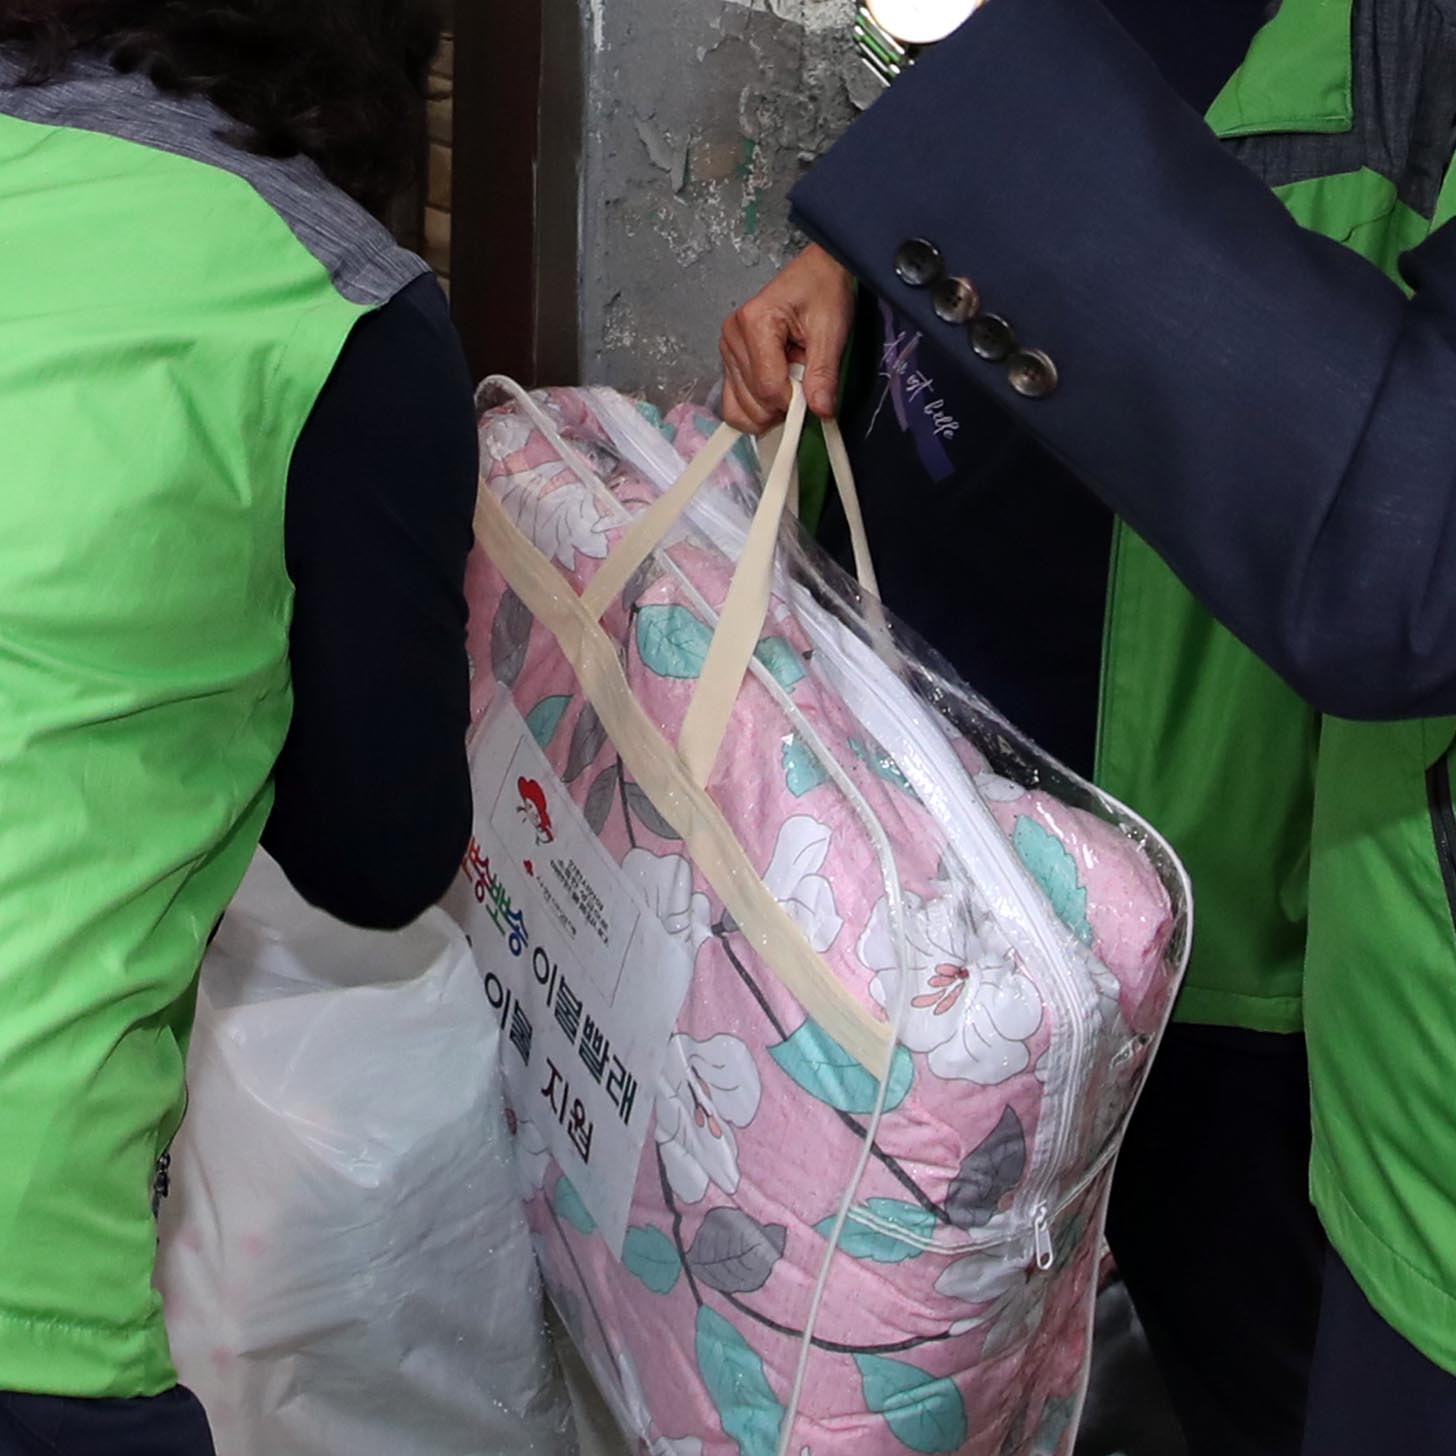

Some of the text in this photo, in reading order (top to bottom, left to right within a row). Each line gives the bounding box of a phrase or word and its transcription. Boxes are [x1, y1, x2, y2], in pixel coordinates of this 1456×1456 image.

[484, 972, 594, 1164] 이불 지원
[532, 946, 638, 1126] 이불빨래
